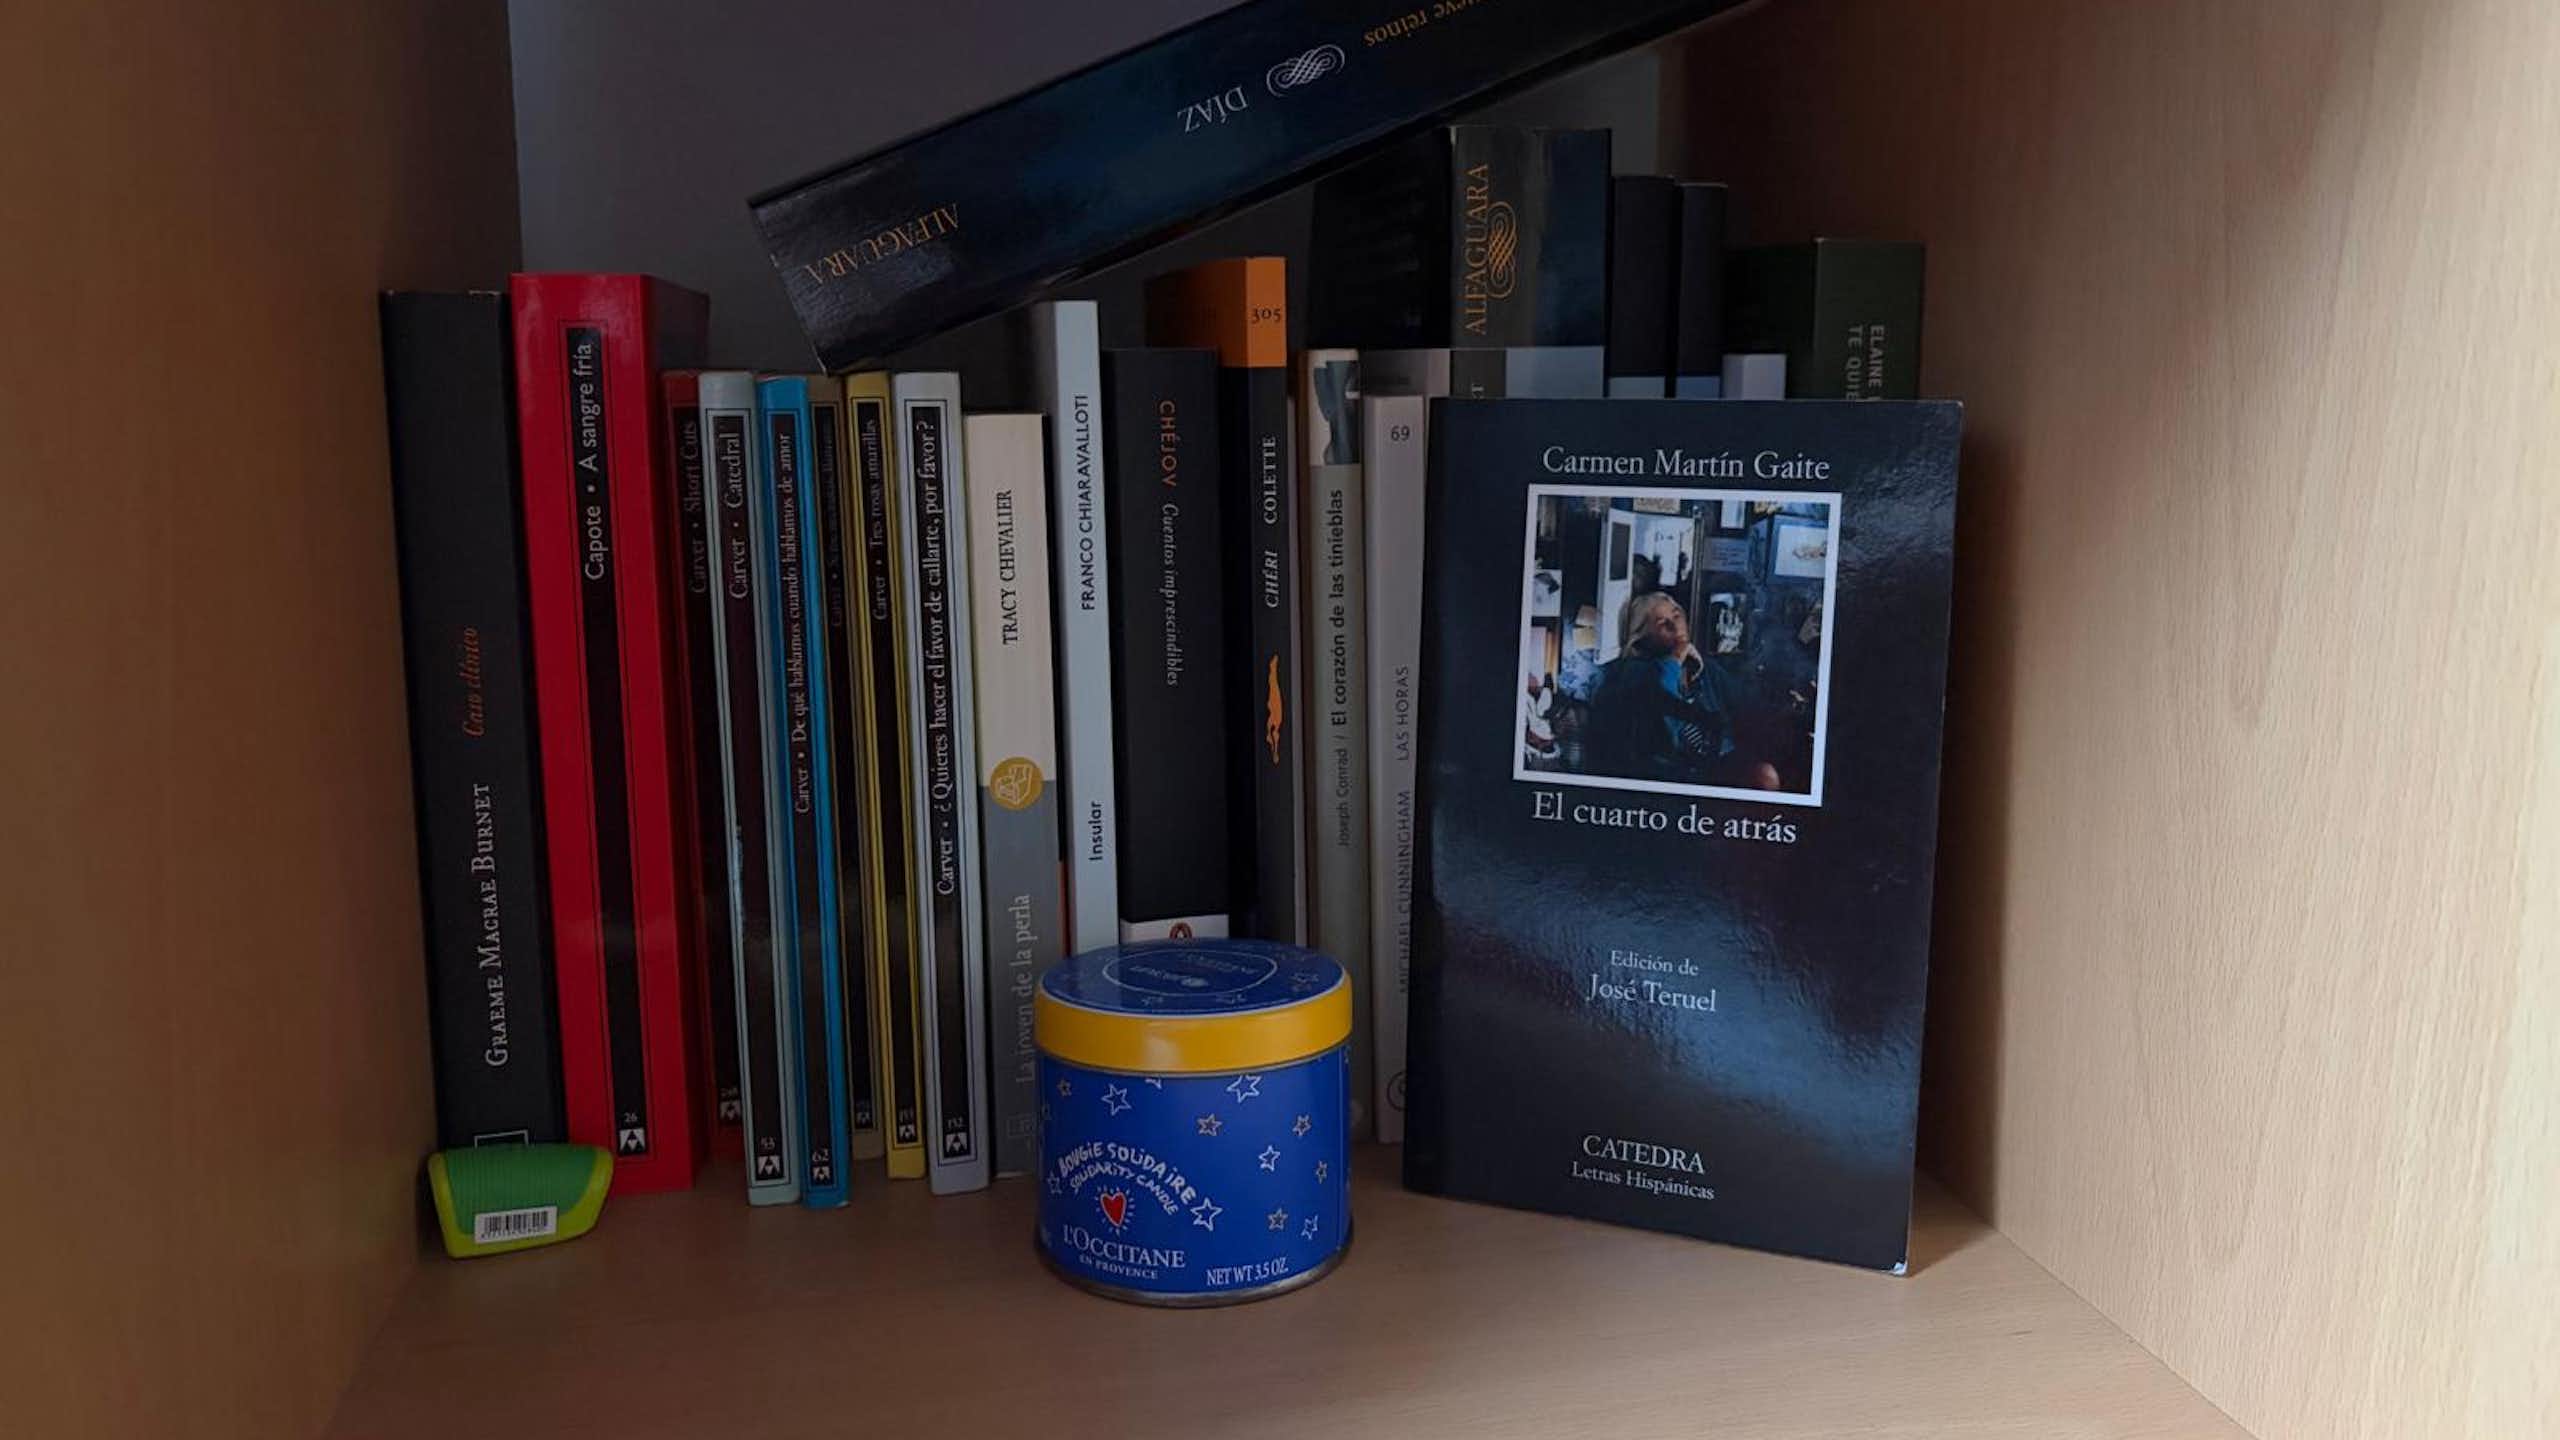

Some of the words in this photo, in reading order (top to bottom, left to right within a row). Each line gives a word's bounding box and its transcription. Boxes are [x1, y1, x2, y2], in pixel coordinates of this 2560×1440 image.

[1362, 8, 1429, 48] reinos
[1433, 0, 1482, 18] ueve
[1177, 85, 1248, 133] DÍAZ
[805, 203, 959, 283] ALFAGUARA
[1463, 163, 1488, 335] ALFAGUARA
[1252, 307, 1281, 323] 305
[1847, 324, 1864, 346] TE
[572, 343, 594, 381] fría
[1867, 324, 1885, 389] ELAINE
[576, 384, 601, 451] sangre
[679, 422, 699, 459] Cuts
[1391, 426, 1410, 440] 69
[577, 454, 598, 471] A
[777, 433, 794, 471] amor
[862, 418, 880, 480] amarillas
[916, 420, 937, 480] favor?
[1075, 395, 1092, 532] CHIARAVALLOTI
[1159, 400, 1180, 487] CHÉJOV
[1542, 447, 1645, 475] Carmen
[1654, 449, 1744, 479] Martín
[1753, 451, 1831, 480] Gaite
[681, 465, 702, 512] Short
[719, 433, 744, 509] Catedral
[778, 476, 795, 494] de
[1262, 435, 1279, 525] COLETTE
[924, 485, 943, 514] por
[584, 504, 609, 581] Capote
[781, 497, 799, 563] hablamos
[869, 521, 884, 546] Tres
[921, 516, 942, 587] callarte,
[996, 490, 1015, 581] CHEVALIER
[1161, 502, 1180, 566] Cuentos
[1327, 490, 1343, 567] tinieblas
[687, 540, 708, 593] Carver
[728, 537, 749, 600] Carver
[1079, 538, 1095, 610] FRANCO
[1261, 550, 1279, 608] CHÉRI
[1329, 571, 1344, 600] las
[785, 567, 802, 619] cuando
[873, 575, 888, 620] Carver
[924, 590, 943, 612] de
[1001, 589, 1018, 645] TRACY
[924, 617, 945, 662] favor
[1160, 569, 1184, 686] imprescindibles
[1330, 606, 1345, 630] de
[458, 625, 482, 689] clínico
[788, 623, 806, 688] hablamos
[927, 664, 946, 680] el
[1330, 633, 1346, 705] corazón
[462, 693, 487, 737] Caso
[790, 692, 809, 717] qué
[929, 682, 948, 729] hacer
[1332, 711, 1347, 726] El
[1397, 666, 1409, 725] HORAS
[792, 720, 808, 742] De
[1397, 731, 1409, 761] LAS
[795, 767, 811, 815] Carver
[1334, 748, 1349, 797] Conrad
[471, 783, 496, 873] BURNET
[1088, 801, 1104, 860] Insular
[1338, 800, 1352, 847] Joseph
[1532, 793, 1564, 821] El
[1573, 803, 1668, 832] cuarto
[1677, 805, 1714, 835] de
[1723, 813, 1798, 844] atrás
[935, 837, 955, 896] Carver
[1398, 791, 1411, 914] CUNNINGHAM
[478, 880, 504, 969] MACRAE
[1007, 894, 1037, 943] perla
[1009, 949, 1031, 966] la
[1610, 950, 1674, 972] Edición
[1678, 958, 1699, 976] de
[1010, 973, 1032, 997] de
[1586, 973, 1637, 1002] José
[1643, 980, 1716, 1012] Teruel
[484, 978, 509, 1067] GRAEME
[1058, 1141, 1104, 1178] BOUGIE
[1107, 1143, 1197, 1205] SOLIDAIRE
[1582, 1134, 1706, 1174] CATEDRA
[1571, 1161, 1621, 1184] Letras
[1626, 1169, 1715, 1200] Hispánicas
[1062, 1223, 1186, 1268] L'OCCITANE
[1095, 1260, 1158, 1280] PROVENCE
[1206, 1266, 1232, 1286] NET
[1233, 1264, 1252, 1283] WT
[1255, 1263, 1270, 1280] 3.5
